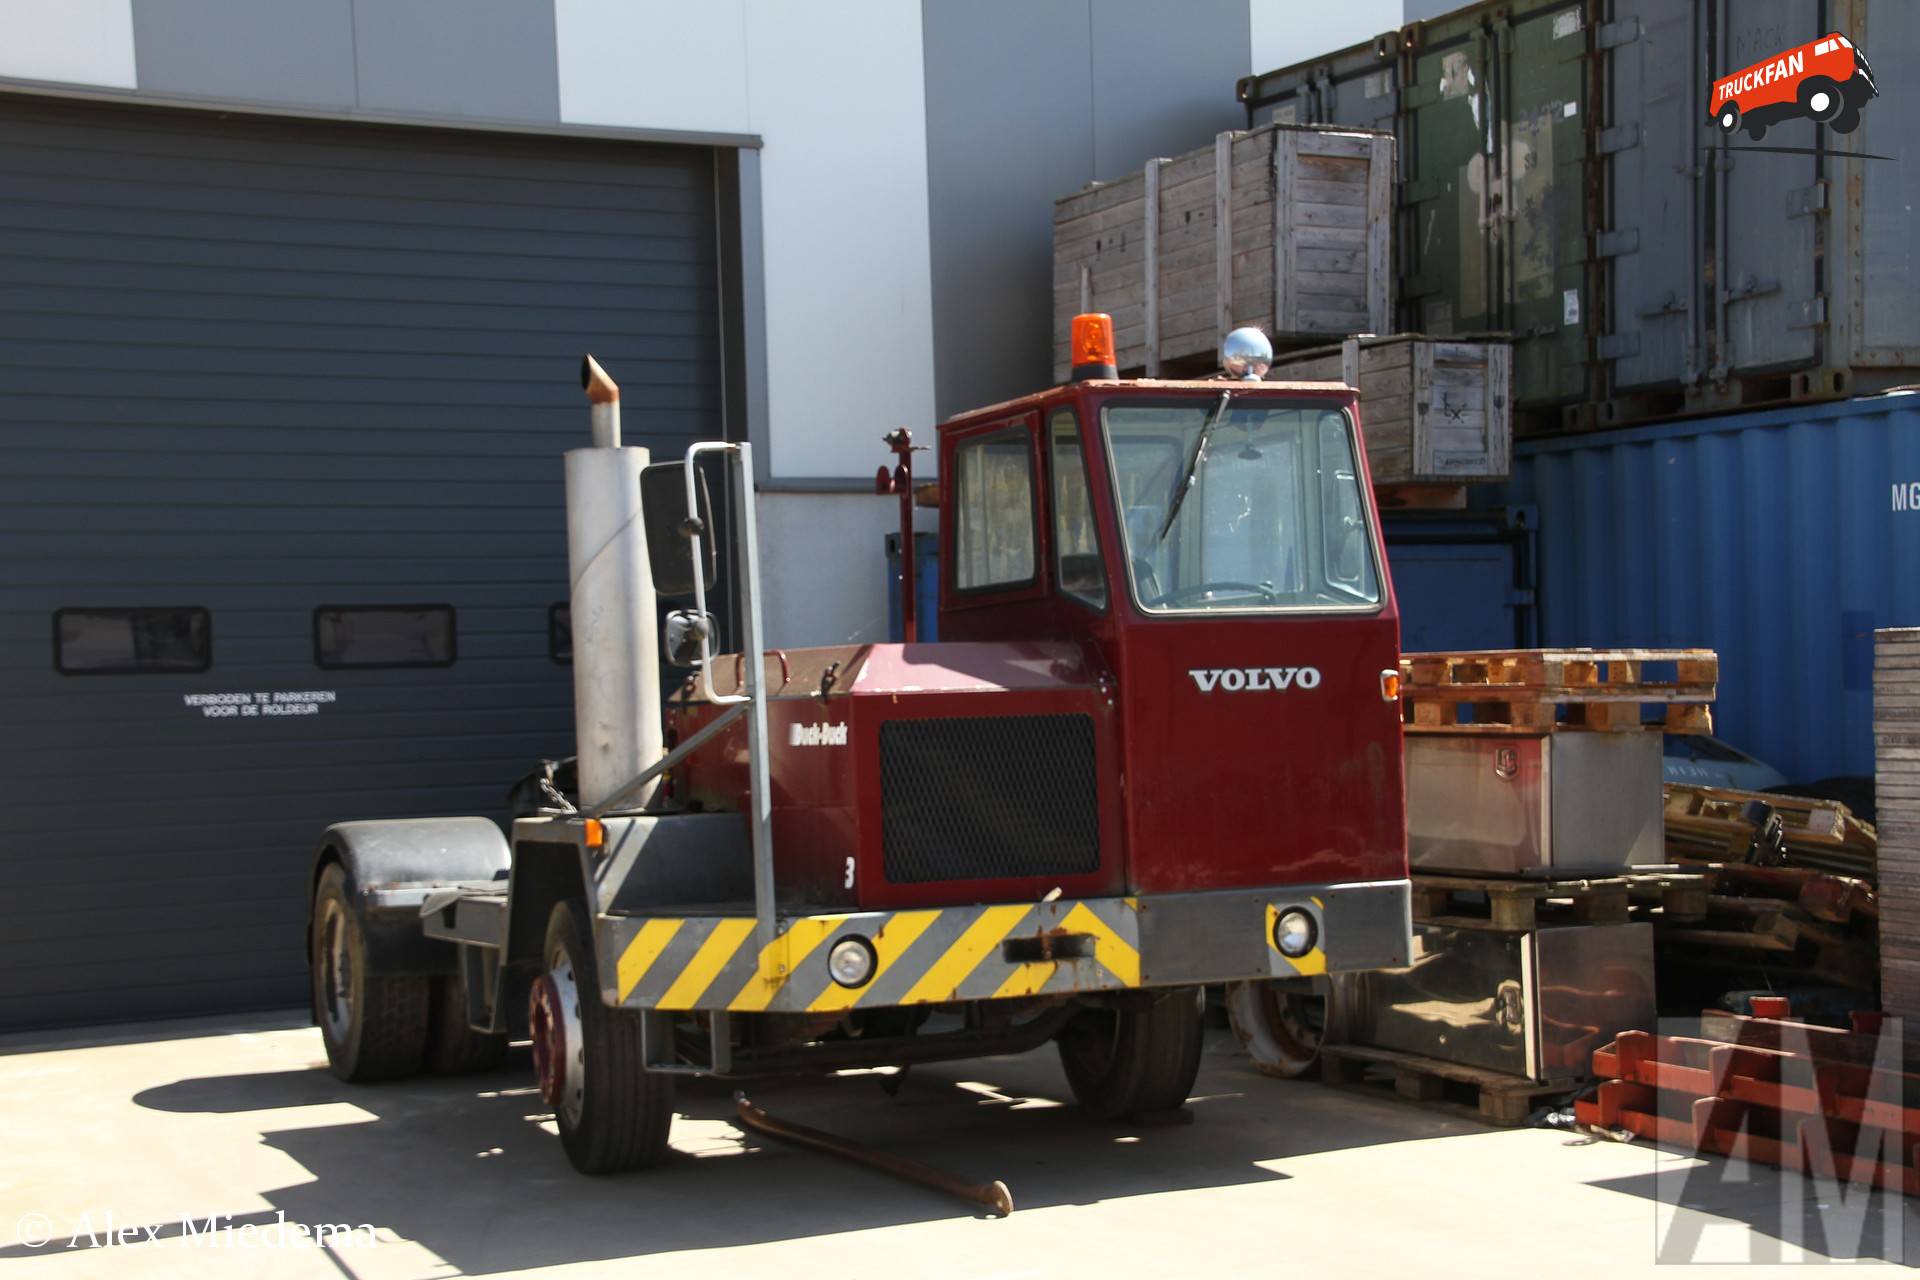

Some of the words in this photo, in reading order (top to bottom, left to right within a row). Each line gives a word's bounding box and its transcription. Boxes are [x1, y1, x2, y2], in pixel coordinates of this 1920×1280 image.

[1188, 666, 1320, 692] VOLVO
[183, 692, 251, 706] VERBODEN
[253, 692, 271, 704] TE
[272, 691, 336, 704] PARKEREN
[202, 705, 239, 717] VOOR
[240, 704, 259, 716] DE
[261, 703, 319, 716] ROLDEUR
[844, 856, 856, 889] 3
